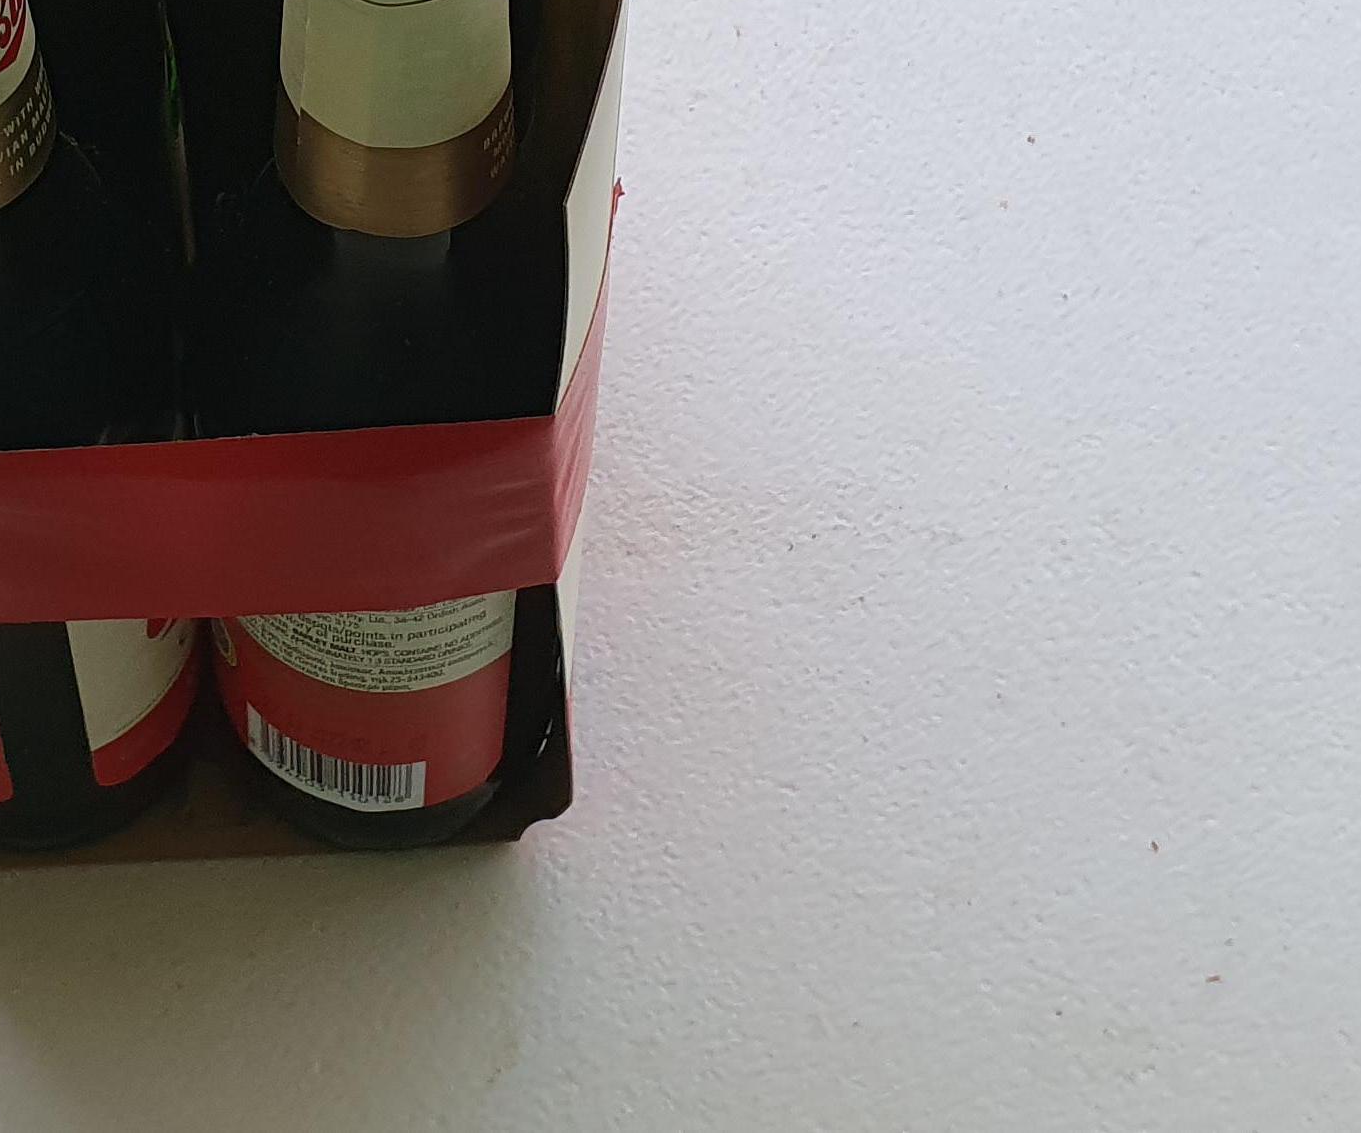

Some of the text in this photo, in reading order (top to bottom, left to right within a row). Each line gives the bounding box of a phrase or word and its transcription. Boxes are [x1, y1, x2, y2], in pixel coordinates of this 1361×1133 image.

[3, 97, 34, 138] WITH
[9, 156, 25, 176] IN
[390, 632, 403, 641] in
[407, 610, 487, 642] participating
